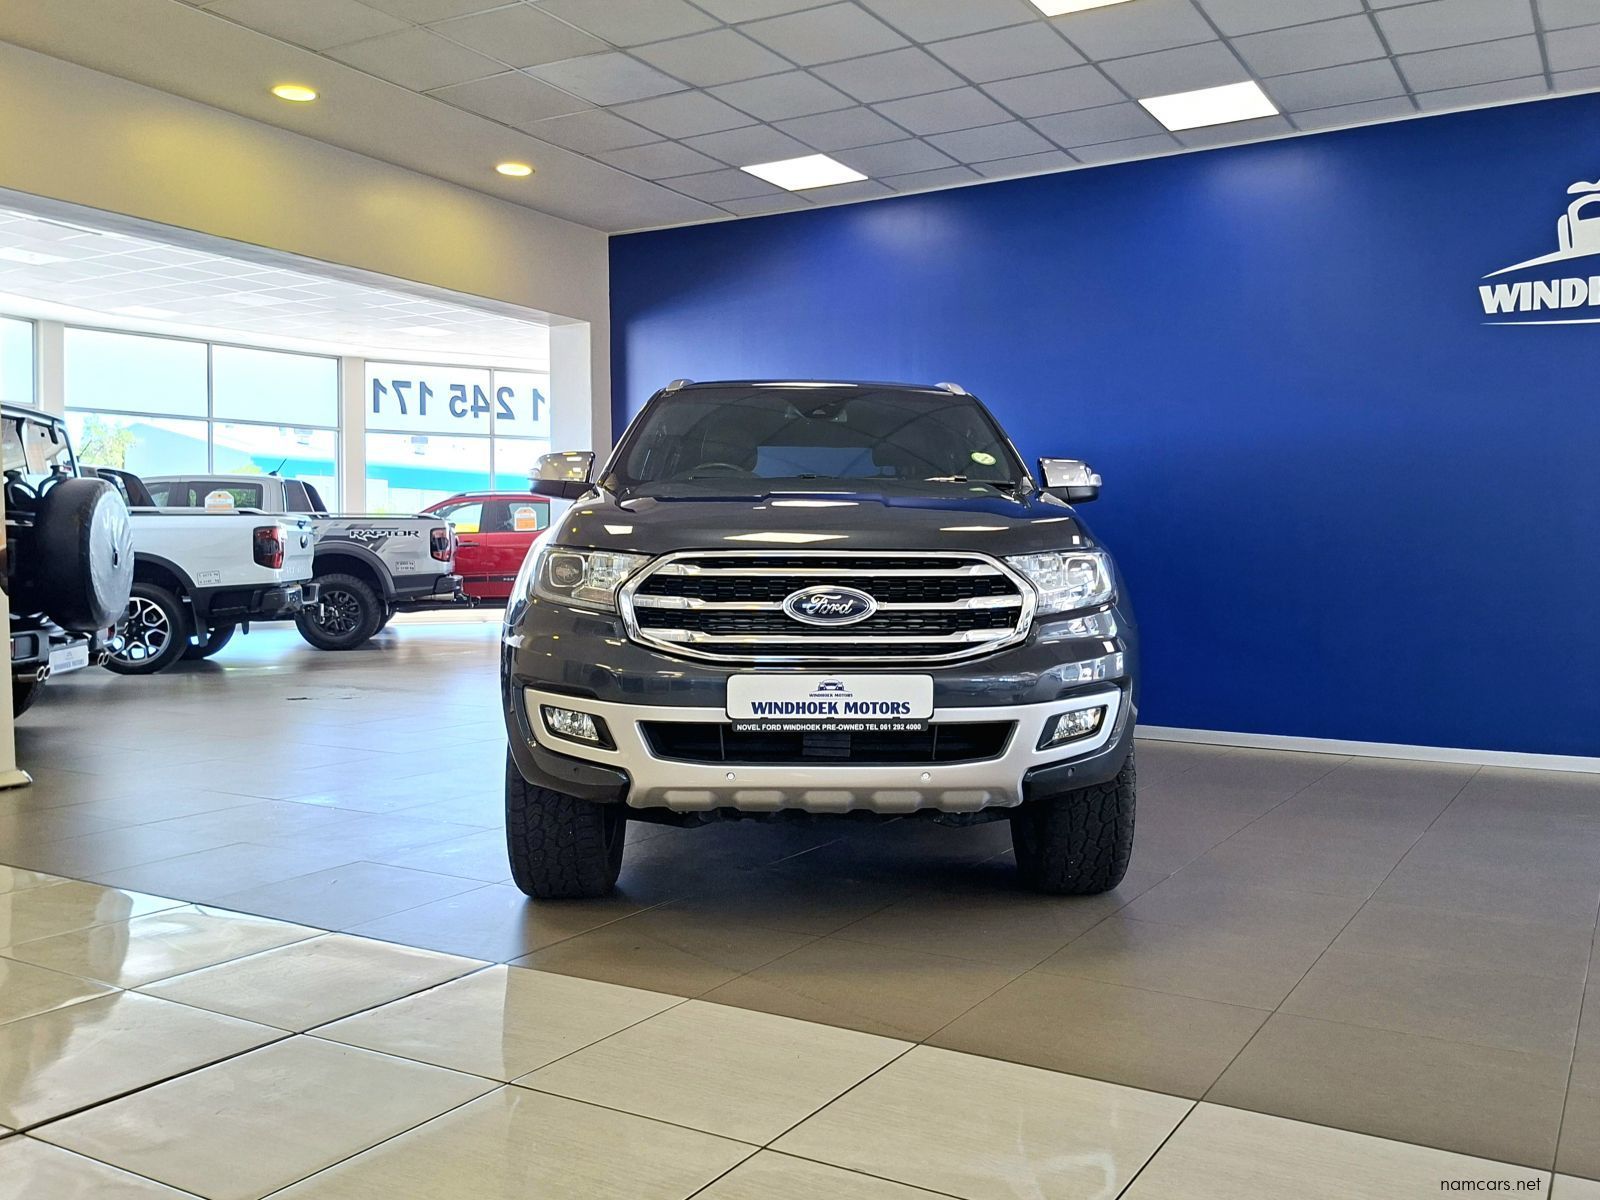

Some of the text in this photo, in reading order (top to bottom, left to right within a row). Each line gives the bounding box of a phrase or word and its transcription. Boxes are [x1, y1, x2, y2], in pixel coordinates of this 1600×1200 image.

[349, 529, 420, 541] RAPTOR
[802, 594, 853, 614] Ford
[751, 701, 911, 715] WINDHOEK MOTORS
[737, 723, 761, 731] NOVEL
[762, 723, 781, 731] FORD
[783, 723, 821, 731] WINDHOEK
[822, 723, 864, 731] PRE-OWNED
[866, 723, 878, 731] TEL
[905, 723, 922, 731] 4000
